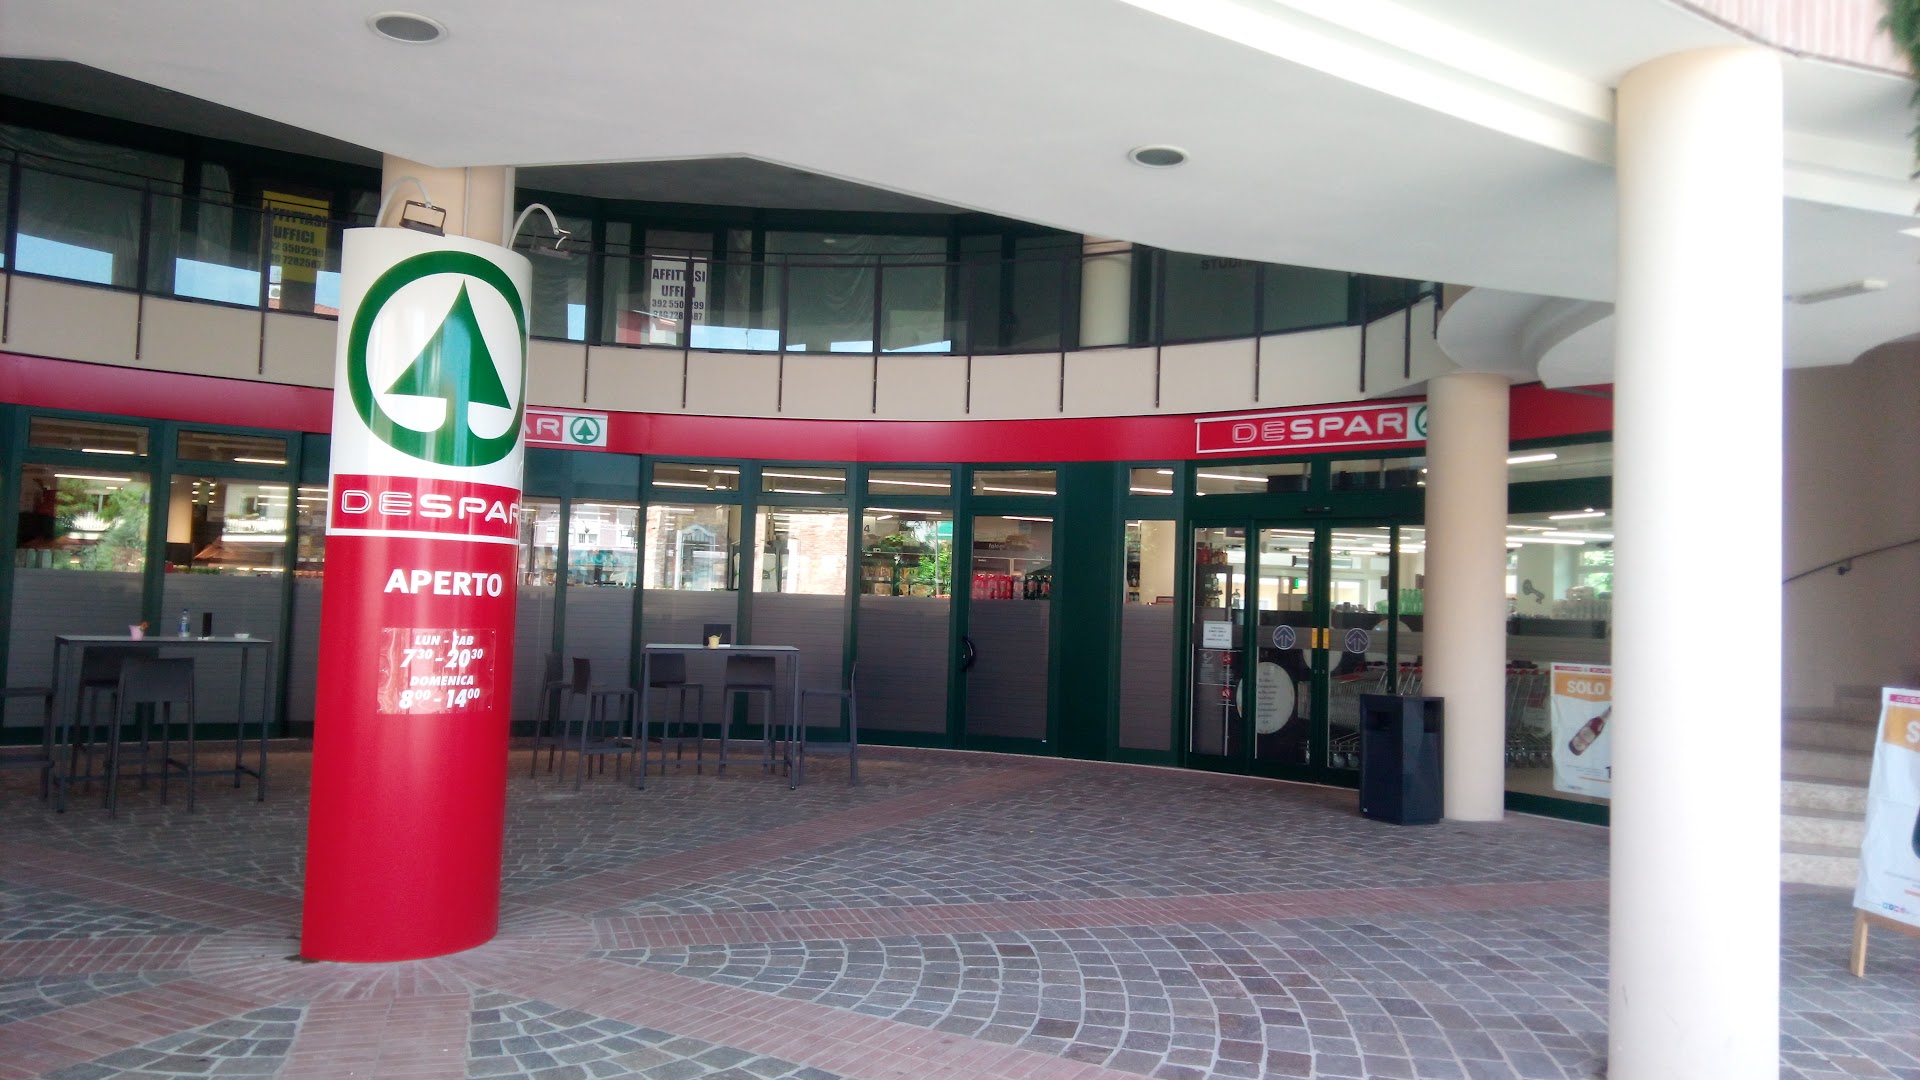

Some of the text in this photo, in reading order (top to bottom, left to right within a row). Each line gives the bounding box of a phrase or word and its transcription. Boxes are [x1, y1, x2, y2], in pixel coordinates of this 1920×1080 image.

[273, 226, 315, 243] UFFICI
[652, 268, 706, 283] AFFITTSI
[669, 300, 704, 310] 55099
[1232, 412, 1404, 444] DESPAR
[341, 489, 519, 525] DESPAR
[384, 569, 502, 597] APERTO
[415, 635, 440, 646] LUN
[410, 675, 474, 686] DOMENICA
